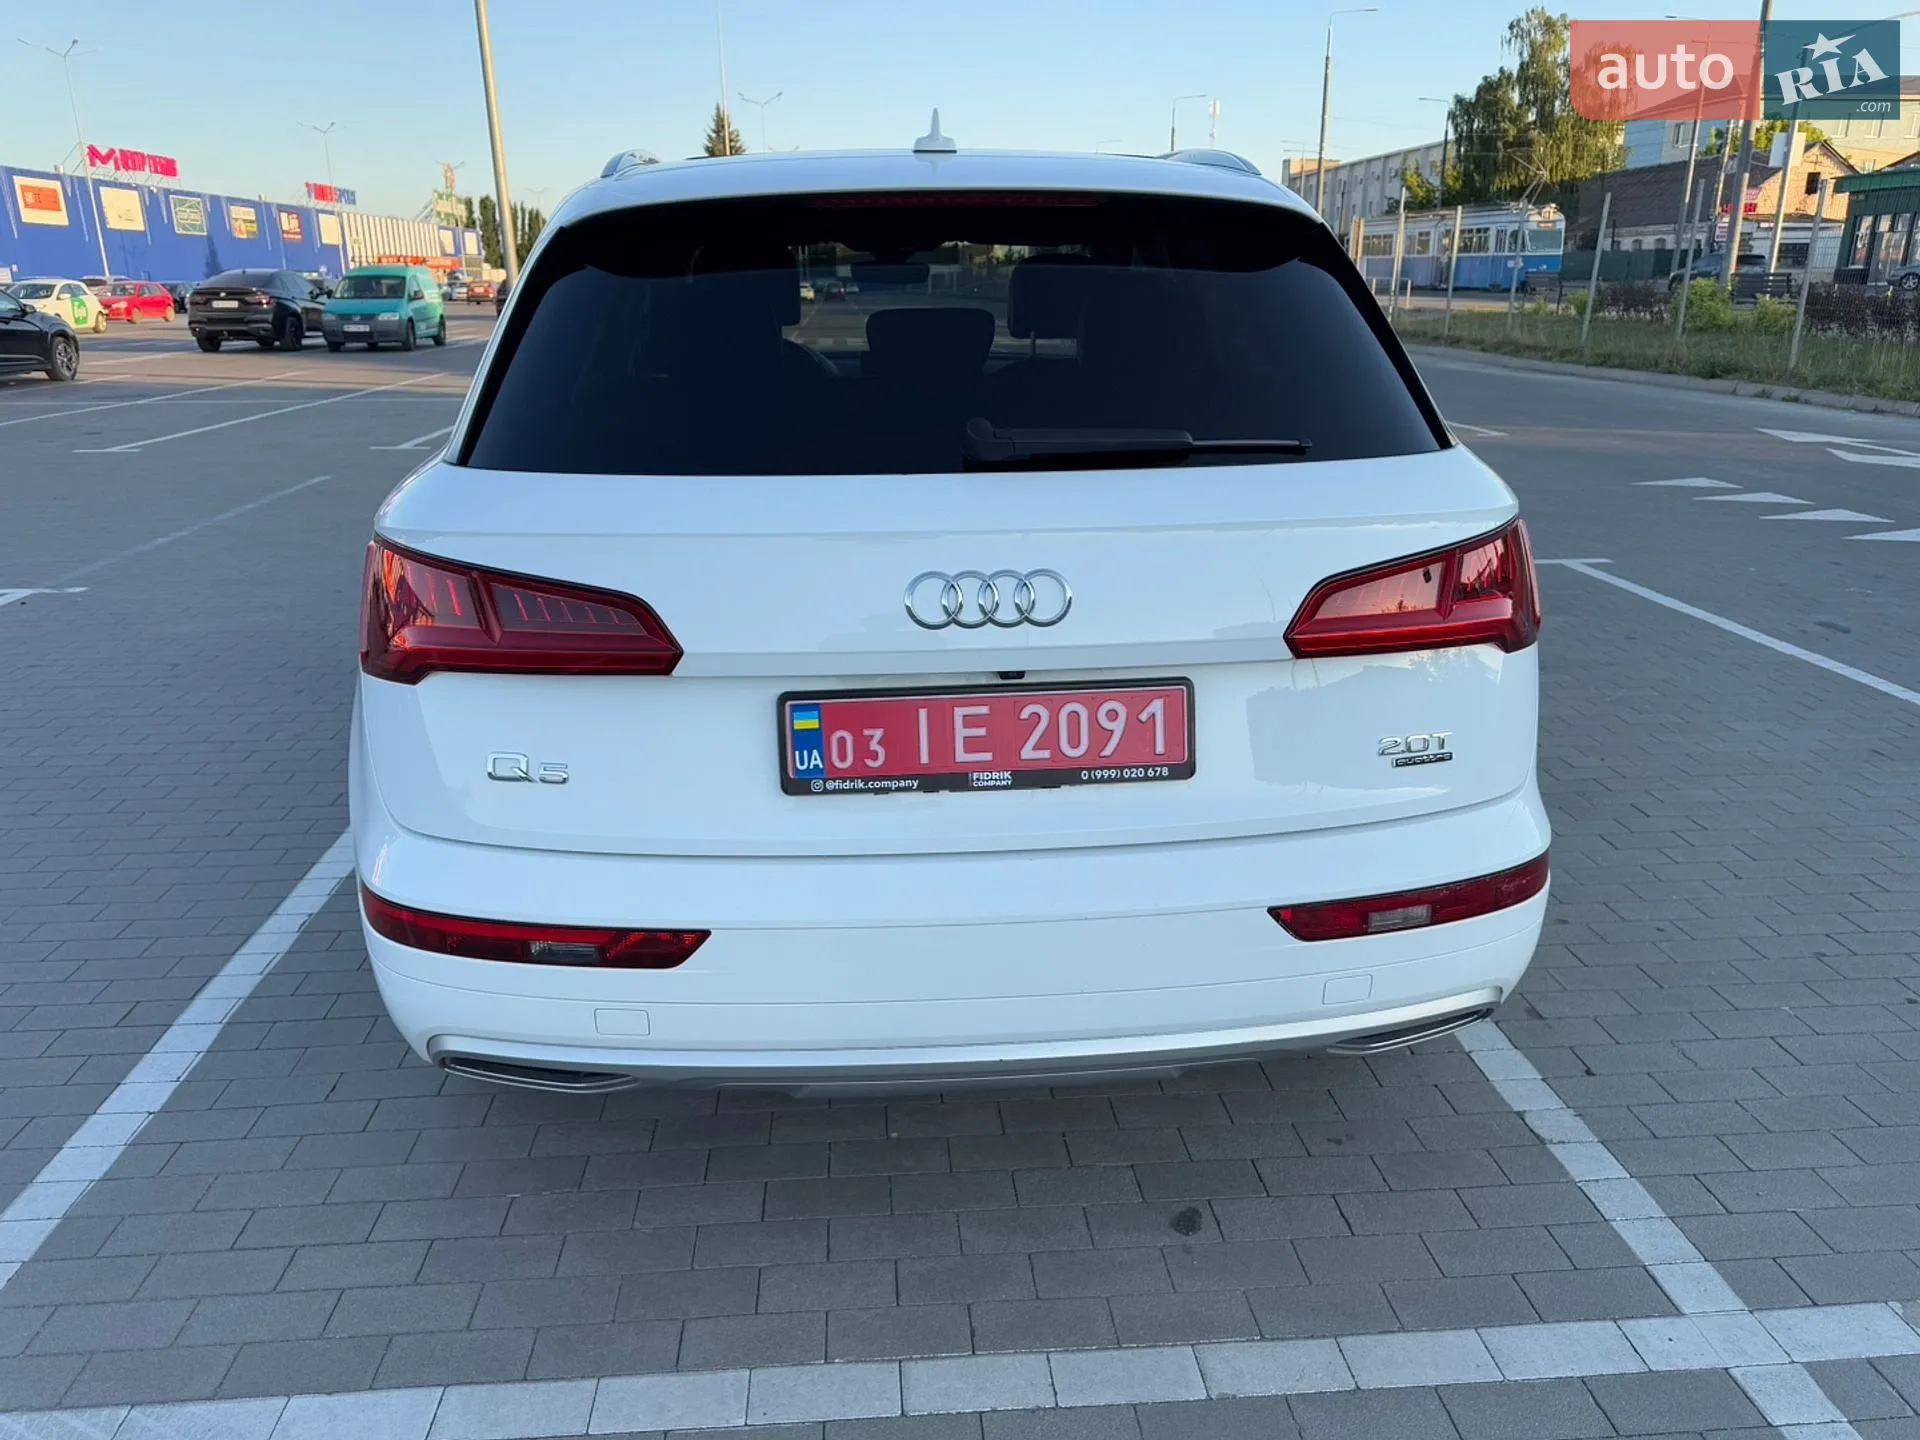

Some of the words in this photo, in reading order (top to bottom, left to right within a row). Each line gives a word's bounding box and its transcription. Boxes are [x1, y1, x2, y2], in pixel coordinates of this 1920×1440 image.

[829, 728, 886, 770] 03
[1019, 697, 1166, 761] 2091
[1378, 731, 1453, 755] 2.0T
[486, 751, 570, 785] Q5
[794, 749, 824, 771] UA
[972, 770, 1012, 780] FIDRIK
[1081, 770, 1089, 780] 0
[1091, 768, 1121, 780] (999)
[1123, 768, 1145, 778] 020
[1147, 766, 1169, 776] 678
[825, 778, 919, 791] @fidrik.company
[972, 779, 1012, 787] COMPANY
